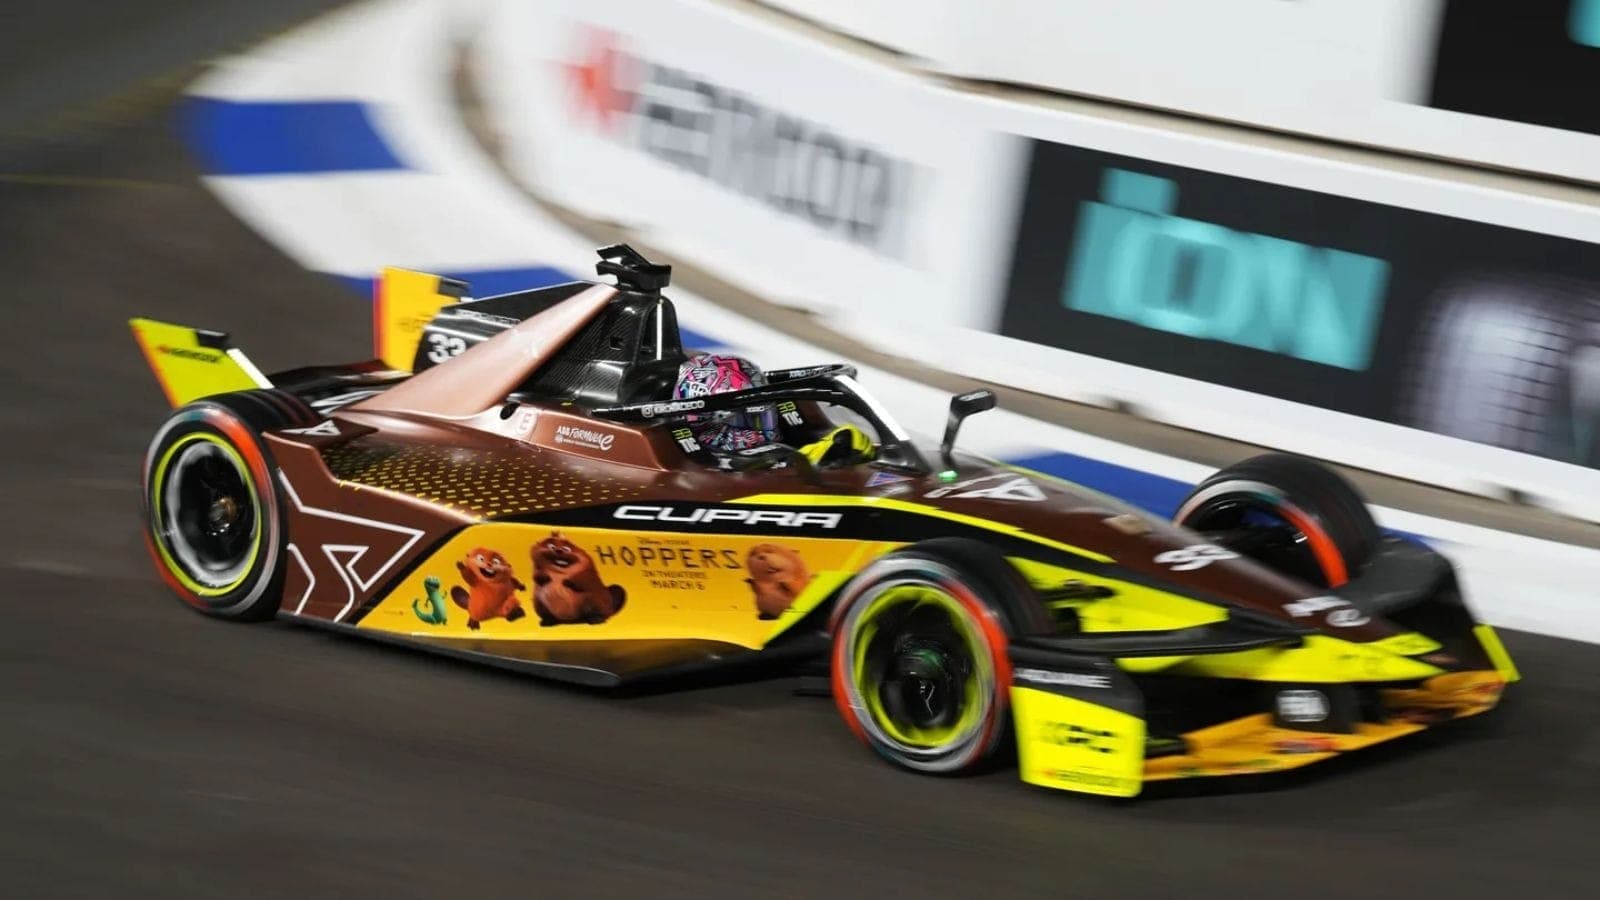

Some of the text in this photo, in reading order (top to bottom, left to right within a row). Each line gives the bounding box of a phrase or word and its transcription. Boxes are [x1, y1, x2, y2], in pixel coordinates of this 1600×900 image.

[612, 504, 844, 529] CUPRA
[595, 545, 742, 569] HOPPERS
[650, 579, 705, 591] MARCH 6
